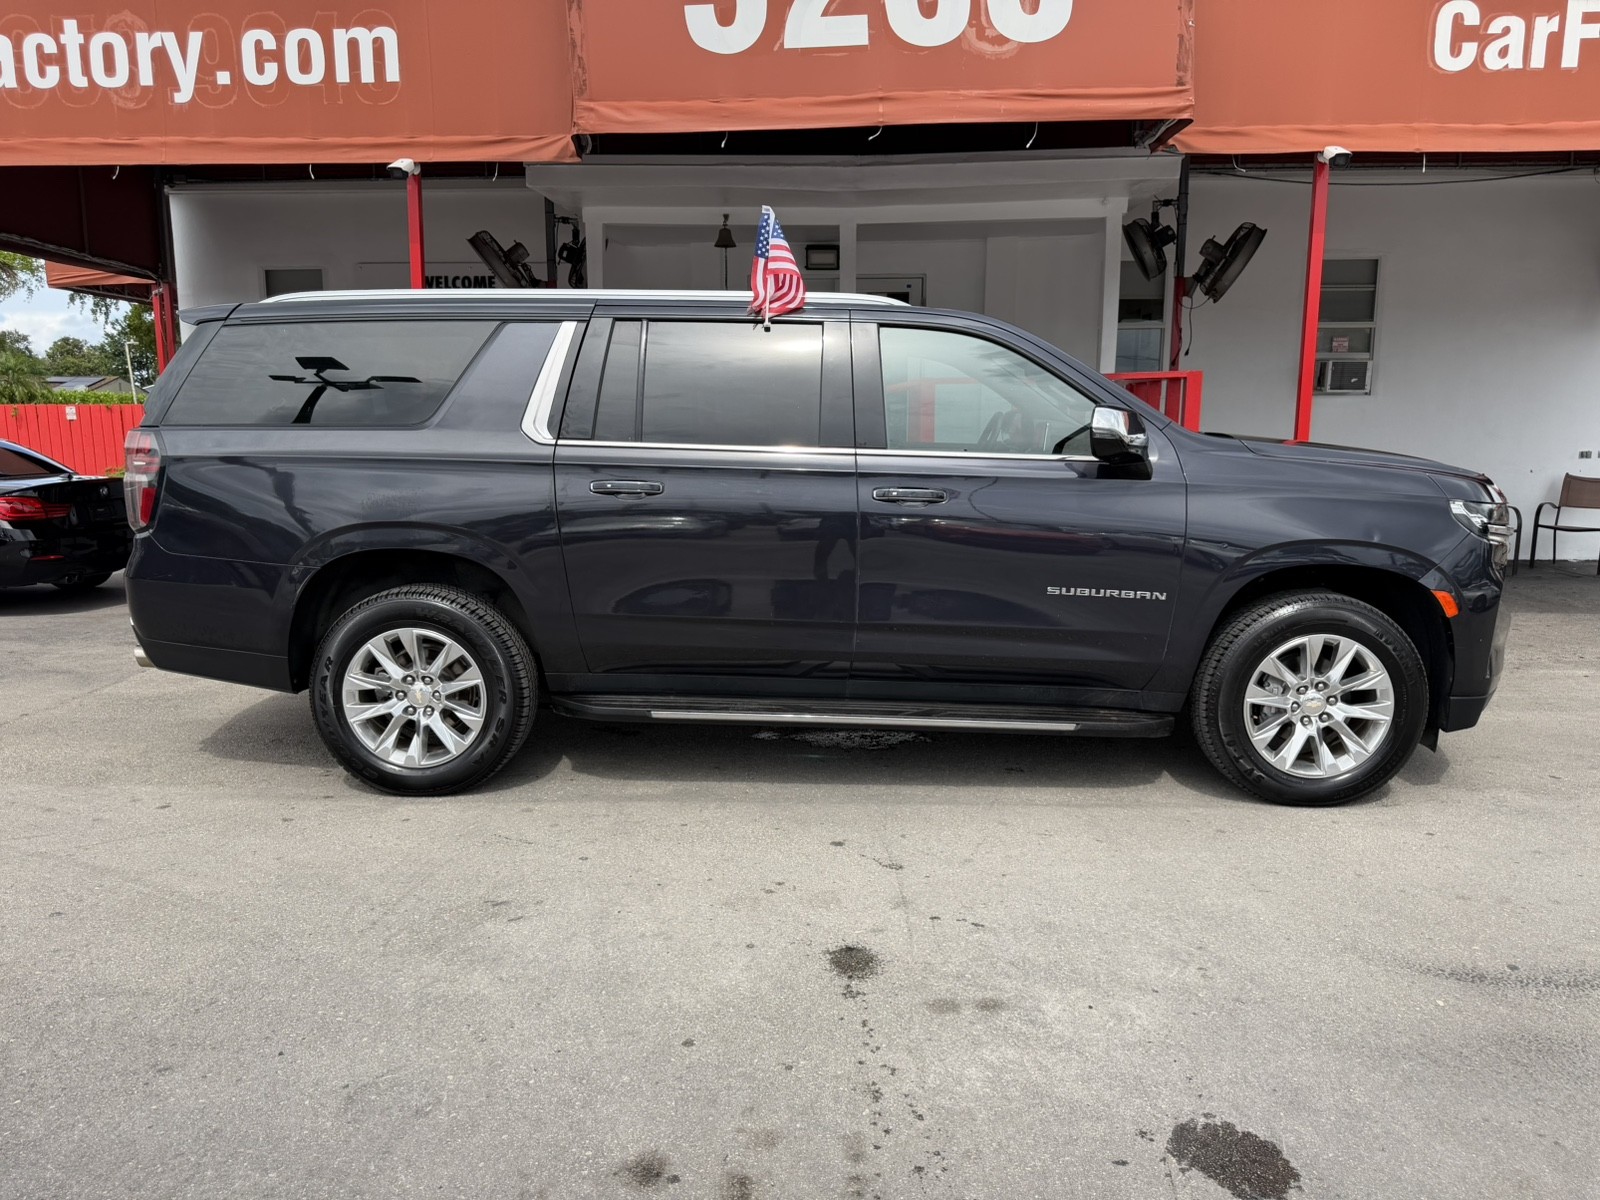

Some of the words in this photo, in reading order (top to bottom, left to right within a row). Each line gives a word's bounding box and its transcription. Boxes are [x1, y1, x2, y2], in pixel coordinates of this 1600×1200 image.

[1434, 0, 1600, 72] CarF
[425, 275, 496, 289] WELCOME
[1046, 586, 1167, 601] SUBURBAN
[319, 655, 380, 780] GOODYEAR
